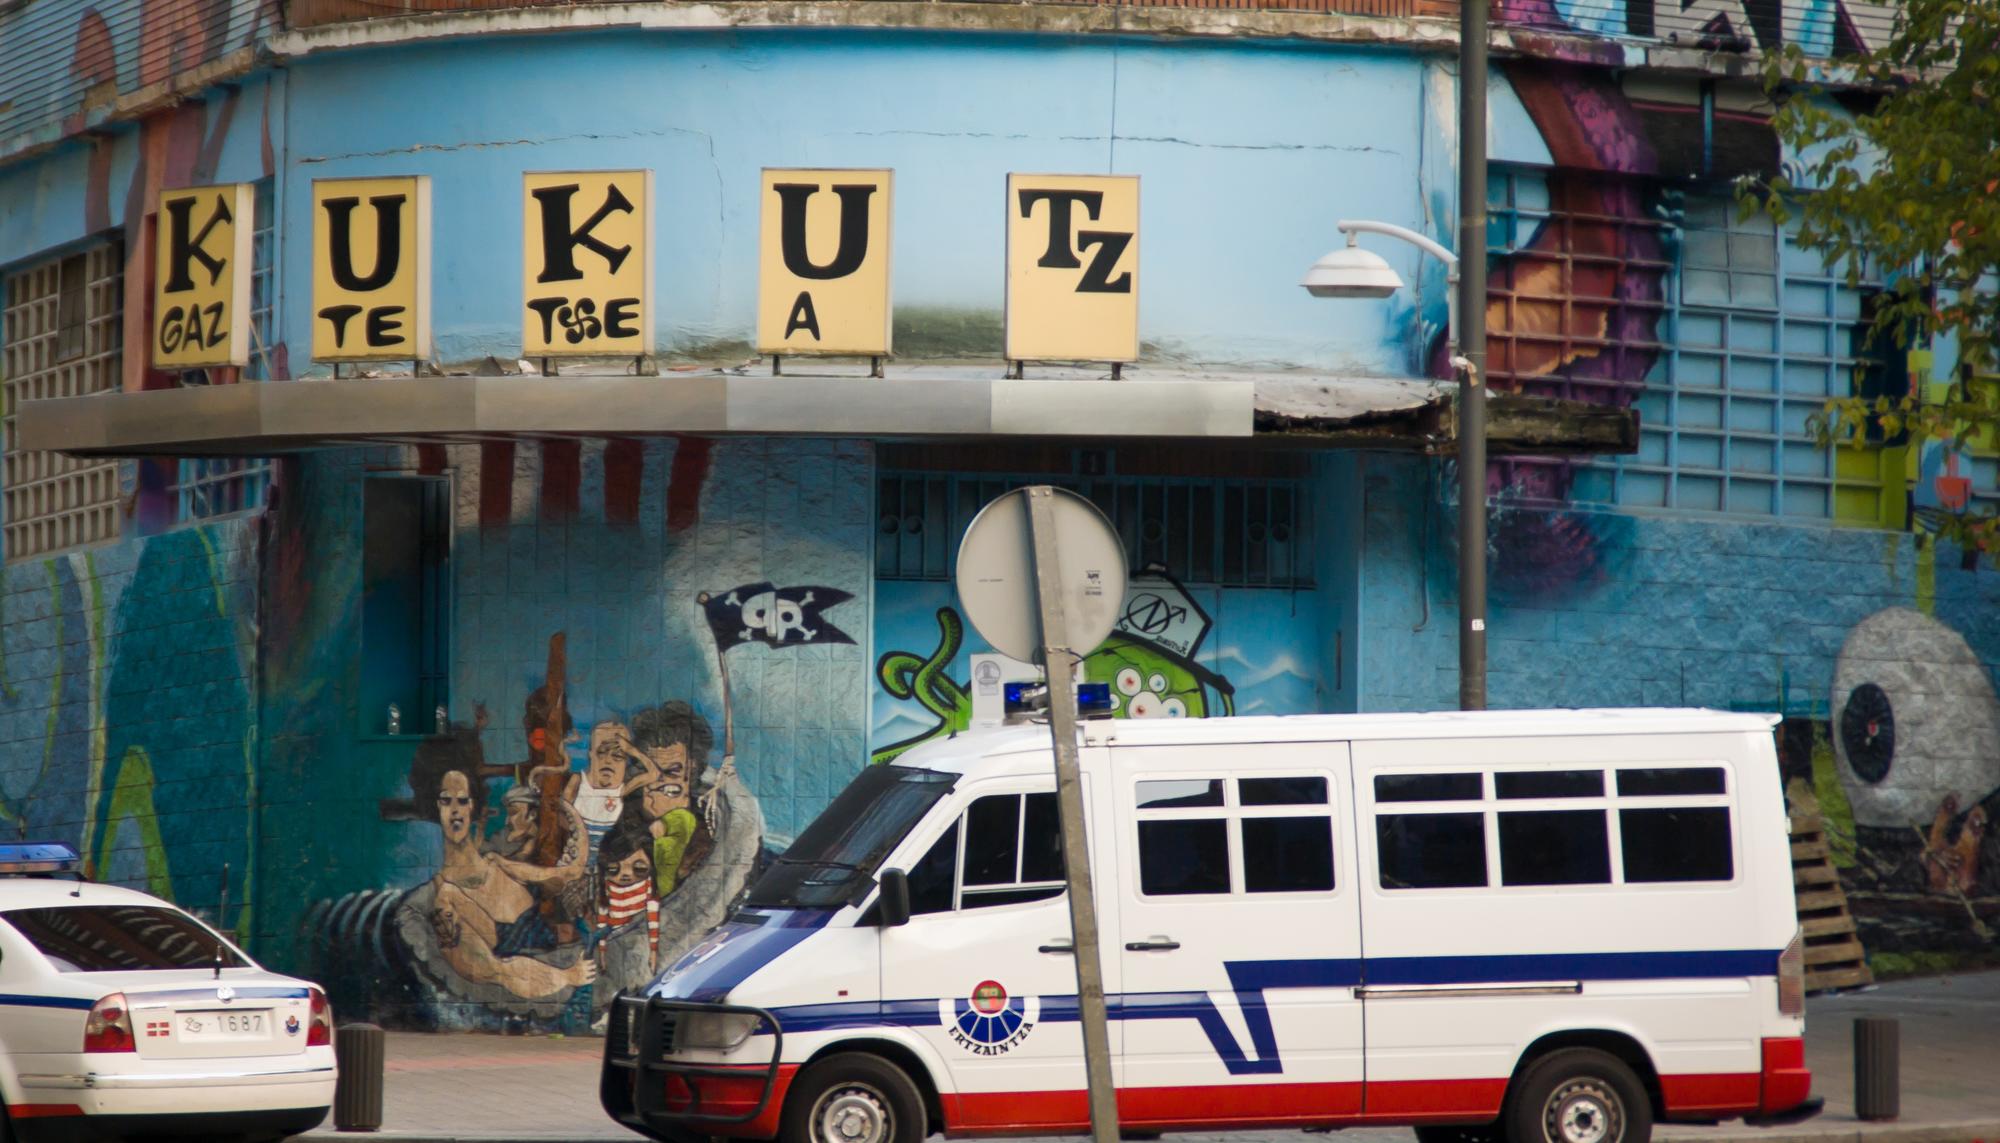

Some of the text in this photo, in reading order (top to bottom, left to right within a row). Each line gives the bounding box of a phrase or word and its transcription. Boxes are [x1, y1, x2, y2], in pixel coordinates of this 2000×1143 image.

[159, 301, 227, 353] GAZ
[318, 305, 405, 348] TE
[784, 291, 821, 340] A
[948, 1022, 1033, 1056] ERTZAINTZA
